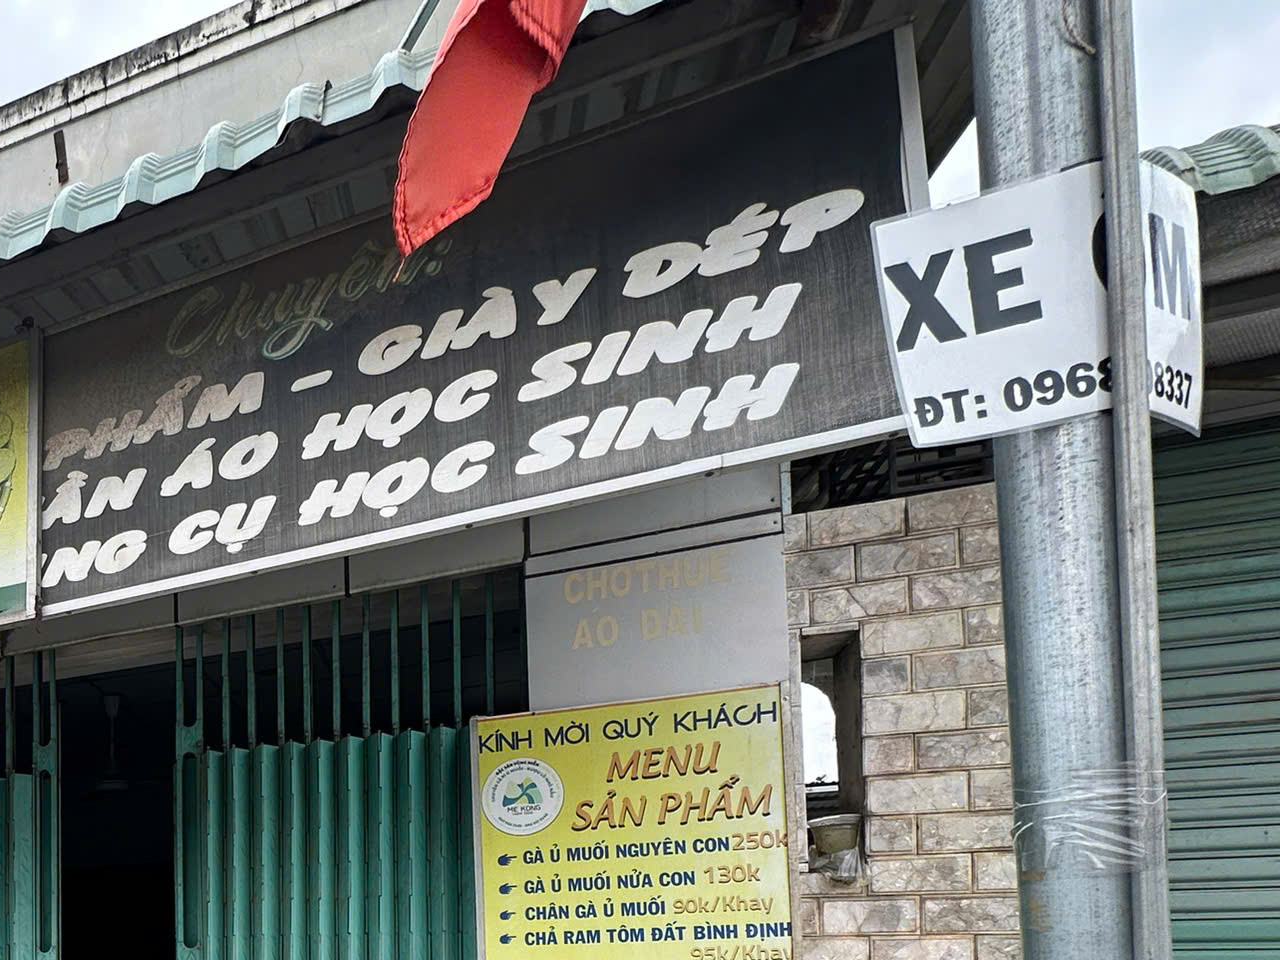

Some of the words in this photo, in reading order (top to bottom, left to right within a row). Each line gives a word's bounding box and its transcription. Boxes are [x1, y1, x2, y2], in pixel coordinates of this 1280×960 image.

[357, 267, 597, 376] GIÀY
[622, 188, 865, 298] DÉP
[883, 228, 1043, 353] XE
[160, 431, 279, 497] ÁO
[301, 369, 499, 460] HỌC
[517, 283, 803, 402] SINH
[914, 388, 989, 429] ĐT:
[41, 529, 148, 589] NG
[168, 495, 277, 554] CỤ
[298, 440, 496, 526] HỌC
[515, 363, 801, 475] SINH
[478, 728, 533, 754] KÍNH
[544, 720, 590, 747] MỜI
[602, 711, 660, 741] QUÝ
[673, 700, 777, 734] KHÁCH
[605, 741, 721, 783] MENU
[571, 789, 648, 832] SẢN
[657, 774, 774, 826] PHẨM
[522, 846, 545, 865] GÀ
[549, 843, 561, 863] Ủ
[566, 840, 610, 862] MUỐI
[615, 837, 687, 859] NGUYÊN
[692, 836, 730, 854] CON
[523, 876, 546, 895] GÀ
[550, 873, 562, 893] Ủ
[567, 870, 611, 892] MUỐI
[616, 868, 654, 889] NỬA
[658, 870, 696, 887] CON
[703, 863, 761, 885] 130k
[524, 902, 570, 921] CHÂN
[574, 900, 598, 919] GÀ
[602, 897, 615, 918] Ủ
[620, 895, 666, 916] MUỐI
[672, 896, 774, 915] 90k/Khay
[524, 925, 559, 946] CHẢ
[563, 929, 602, 945] RAM
[605, 924, 645, 943] TÔM
[650, 921, 687, 942] ĐẤT
[693, 921, 738, 941] BÌNH
[744, 921, 793, 942] ĐỊNH
